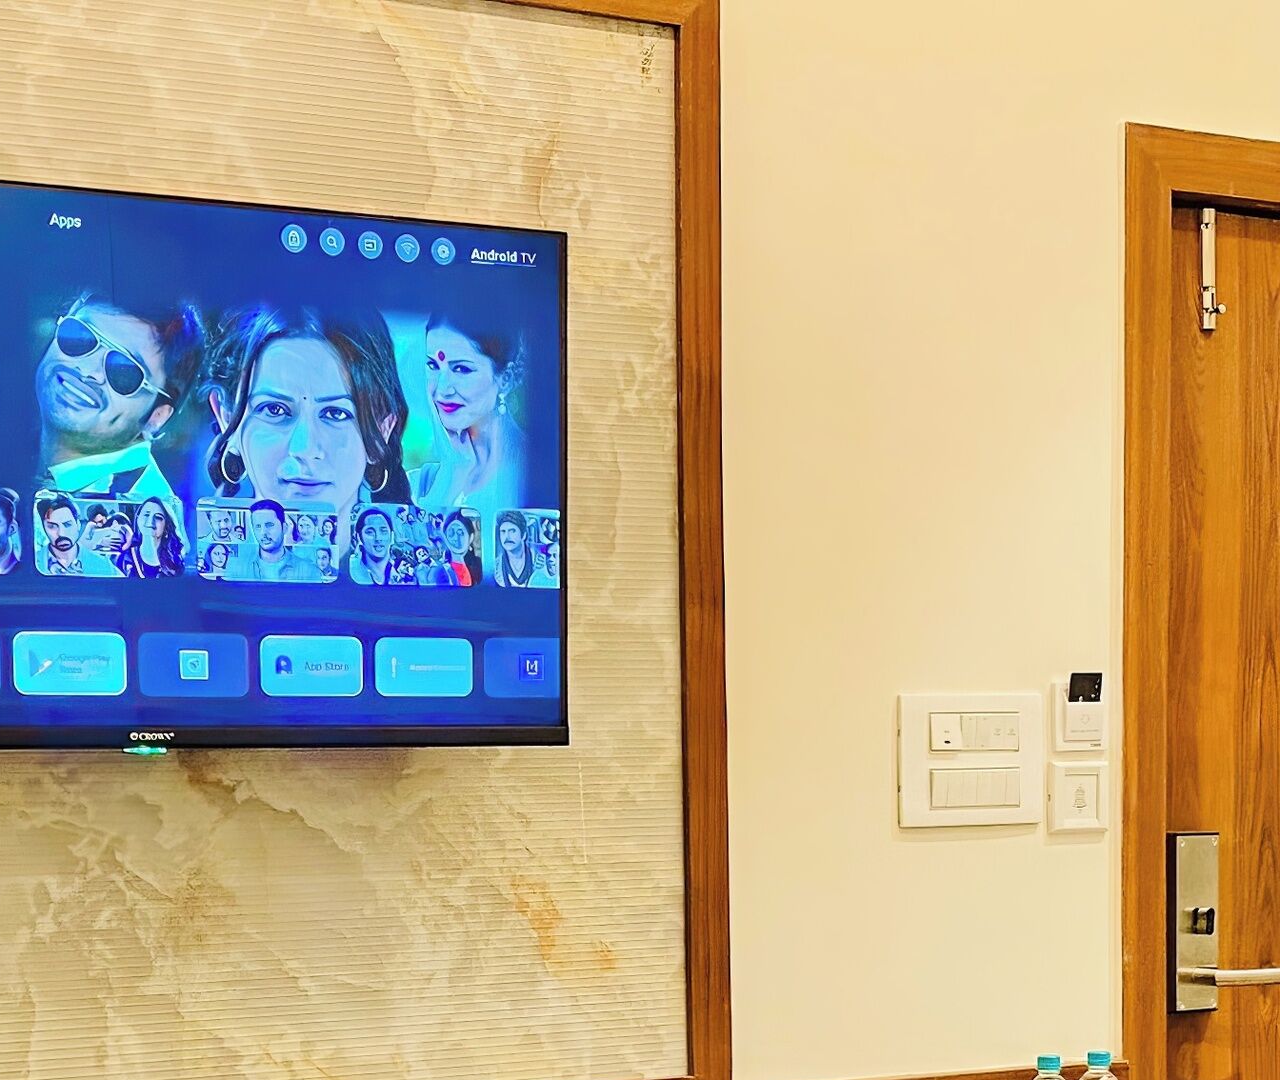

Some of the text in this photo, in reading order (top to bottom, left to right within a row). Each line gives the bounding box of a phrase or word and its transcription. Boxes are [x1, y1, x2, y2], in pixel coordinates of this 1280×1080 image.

[49, 212, 82, 230] Apps
[470, 248, 537, 264] Android TV
